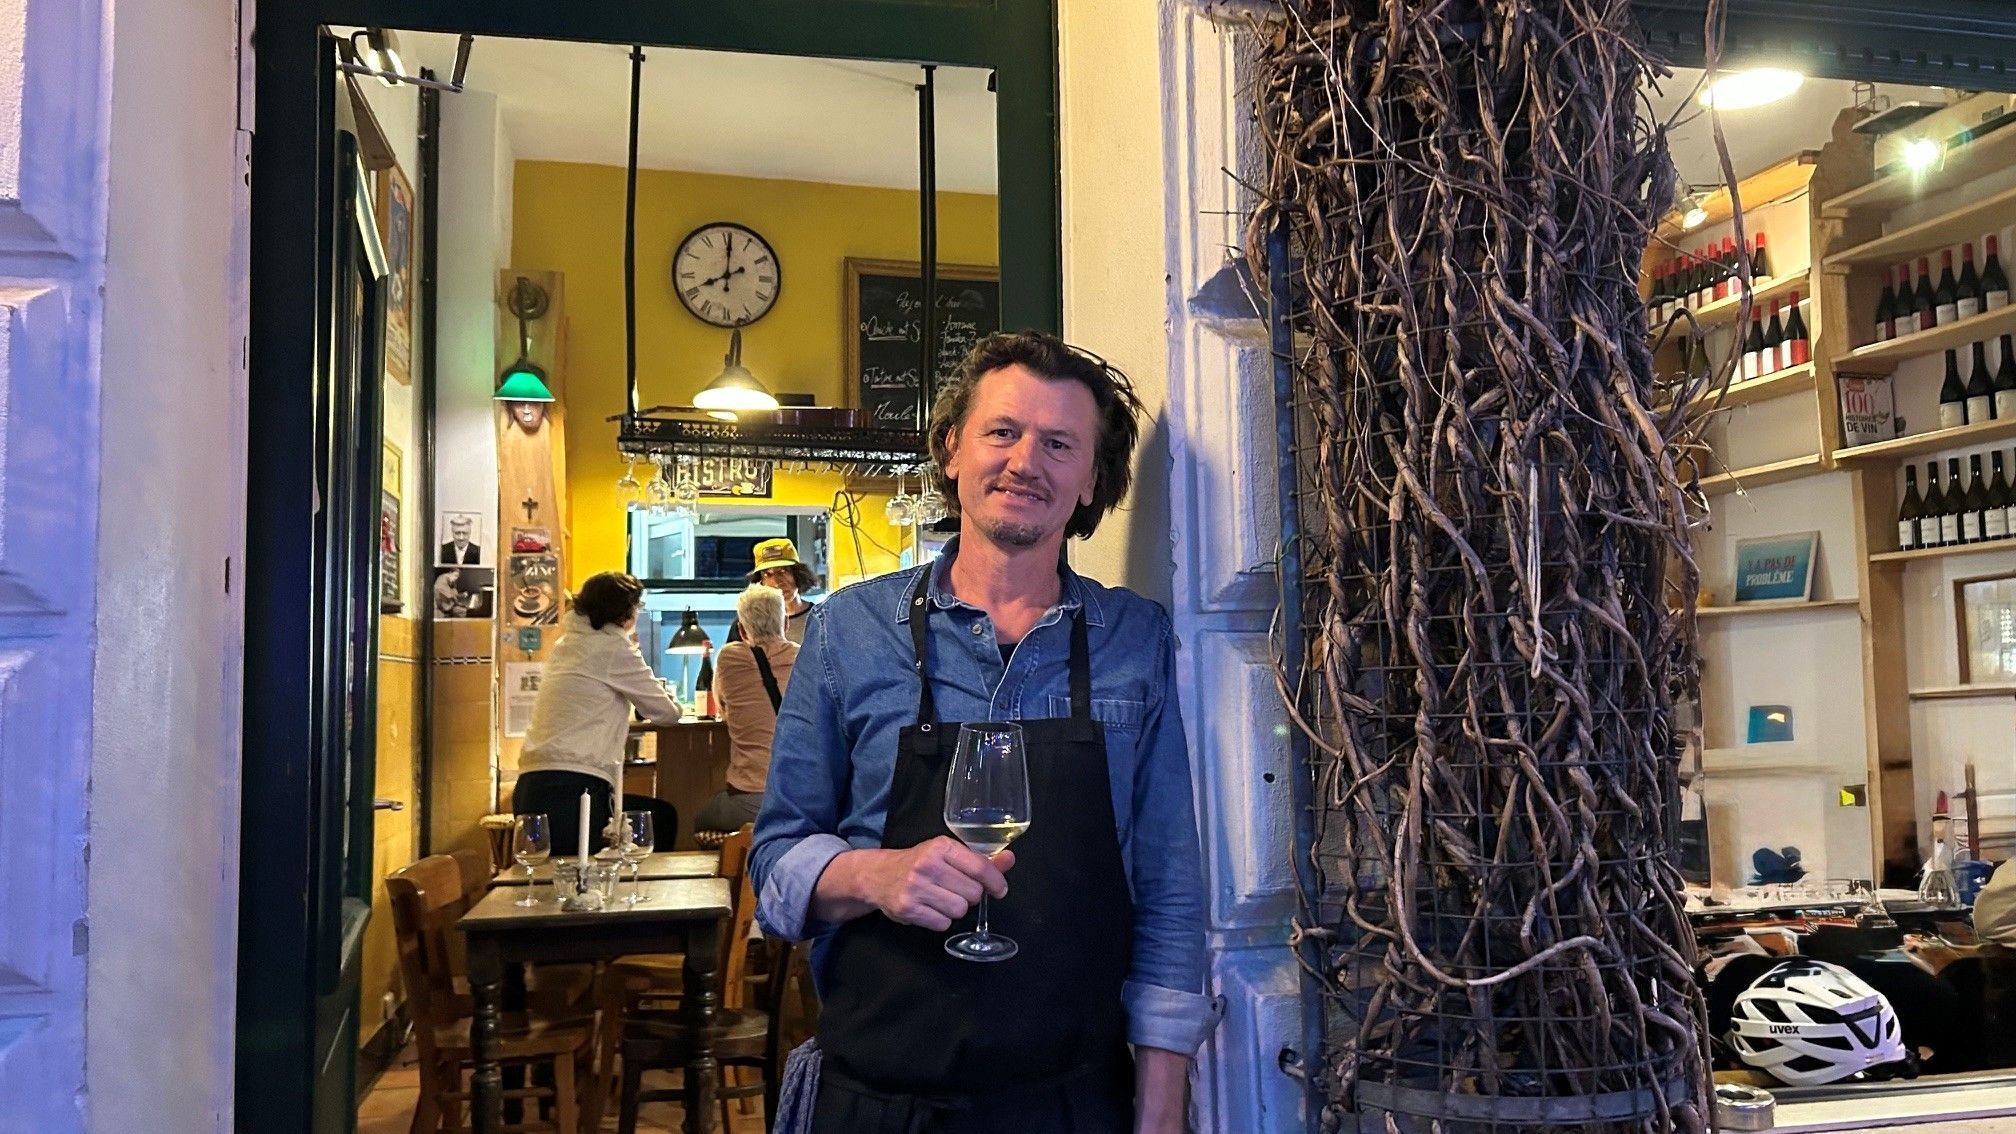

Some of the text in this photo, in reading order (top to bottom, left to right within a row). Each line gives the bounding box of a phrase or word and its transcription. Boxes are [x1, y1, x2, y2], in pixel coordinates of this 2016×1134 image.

[1846, 422, 1878, 433] DE VIN
[1769, 1025, 1800, 1035] uvex
